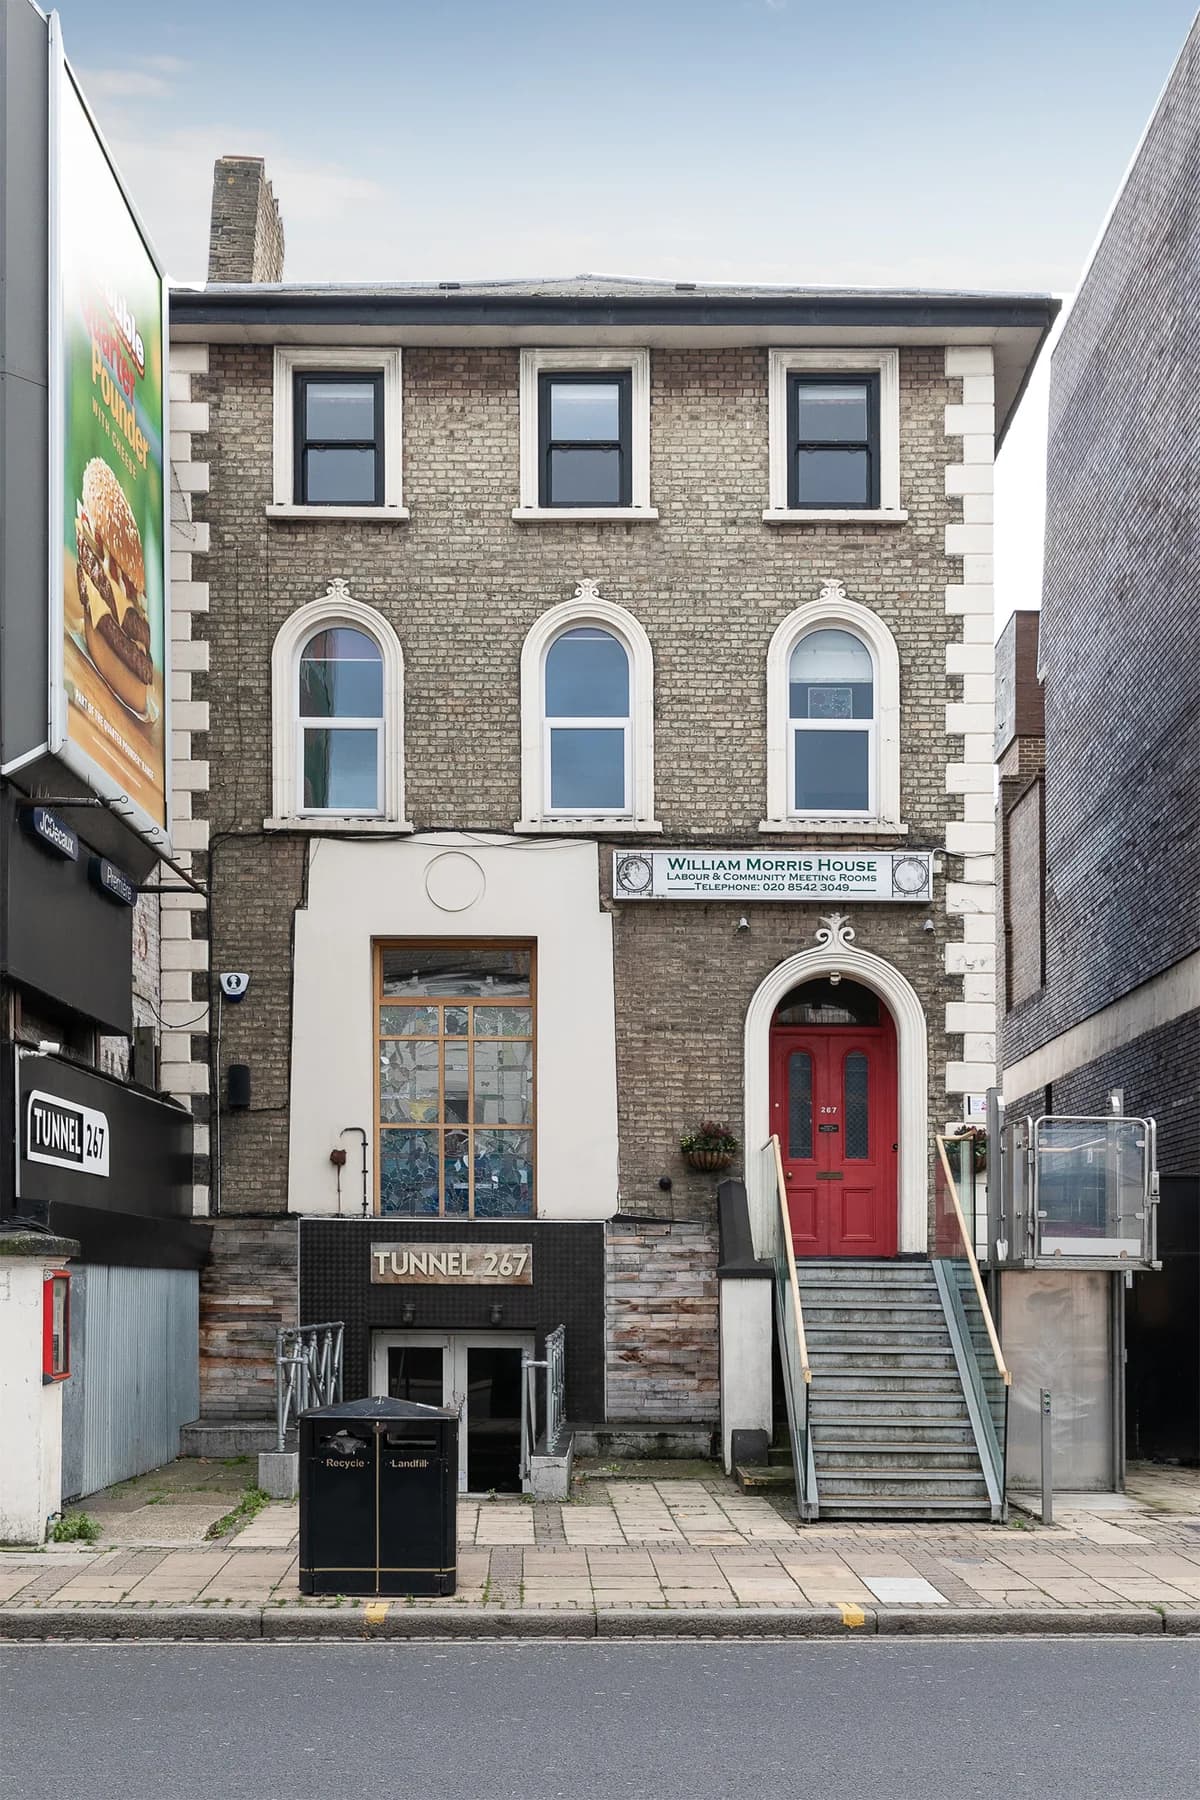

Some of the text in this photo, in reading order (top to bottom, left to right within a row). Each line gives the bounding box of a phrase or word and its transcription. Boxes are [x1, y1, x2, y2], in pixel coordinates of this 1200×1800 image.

[112, 430, 136, 480] CHEESE
[40, 811, 74, 854] JCDecaux
[667, 858, 877, 871] WILLIAM MORRIS HOUSE
[723, 873, 786, 881] COMMUNITY
[789, 873, 836, 881] MEETING
[694, 882, 850, 892] TELEPHONE: 020 8542 3049
[820, 1106, 837, 1114] 267
[34, 1107, 105, 1160] TUNNEL 267
[373, 1251, 528, 1276] TUNNEL 267
[326, 1458, 365, 1469] Recycle
[391, 1459, 427, 1468] Landfill
